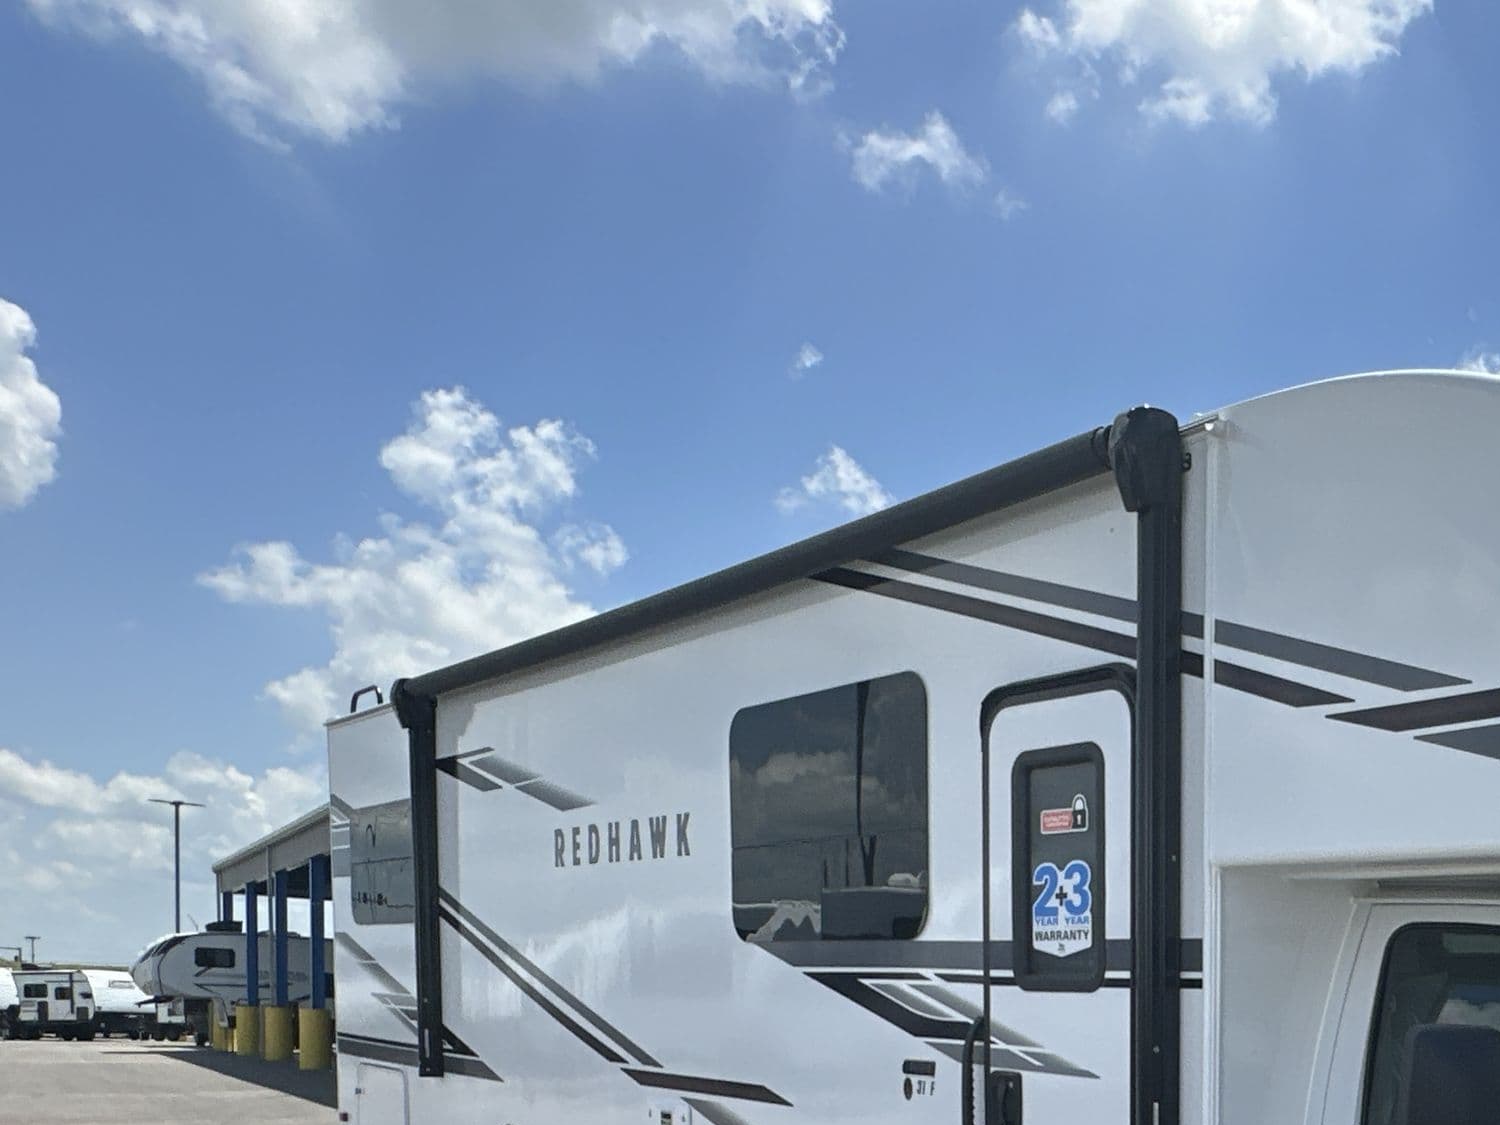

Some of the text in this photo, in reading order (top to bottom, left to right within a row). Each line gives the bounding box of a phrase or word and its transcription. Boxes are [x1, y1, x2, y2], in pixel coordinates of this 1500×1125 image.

[554, 812, 691, 868] REDHAWK
[1036, 915, 1090, 926] YEAR YEAR
[1035, 929, 1089, 941] WARRANTY
